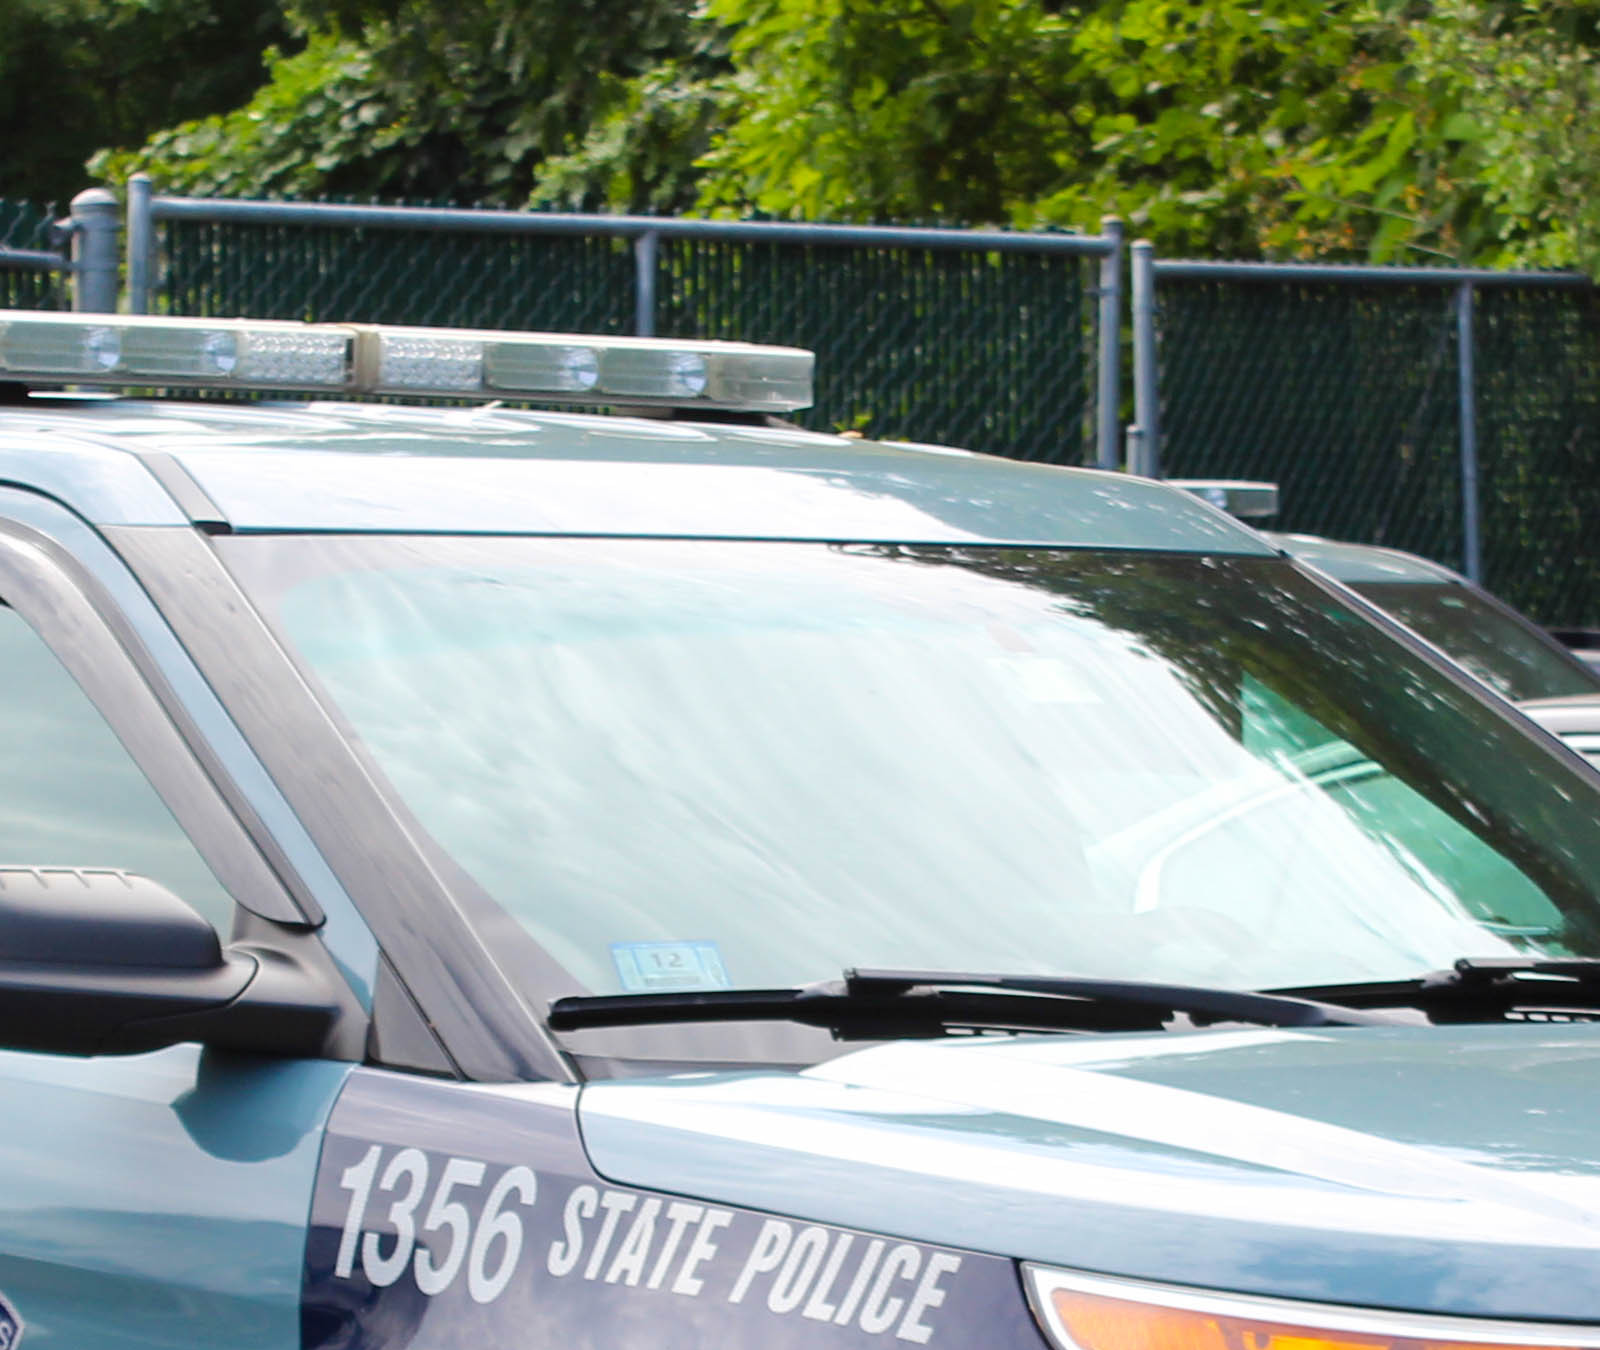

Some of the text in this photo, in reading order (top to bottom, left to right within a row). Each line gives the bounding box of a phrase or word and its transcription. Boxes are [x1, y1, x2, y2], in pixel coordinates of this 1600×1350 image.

[333, 1144, 537, 1305] 1356
[546, 1184, 963, 1345] STATE POLICE
